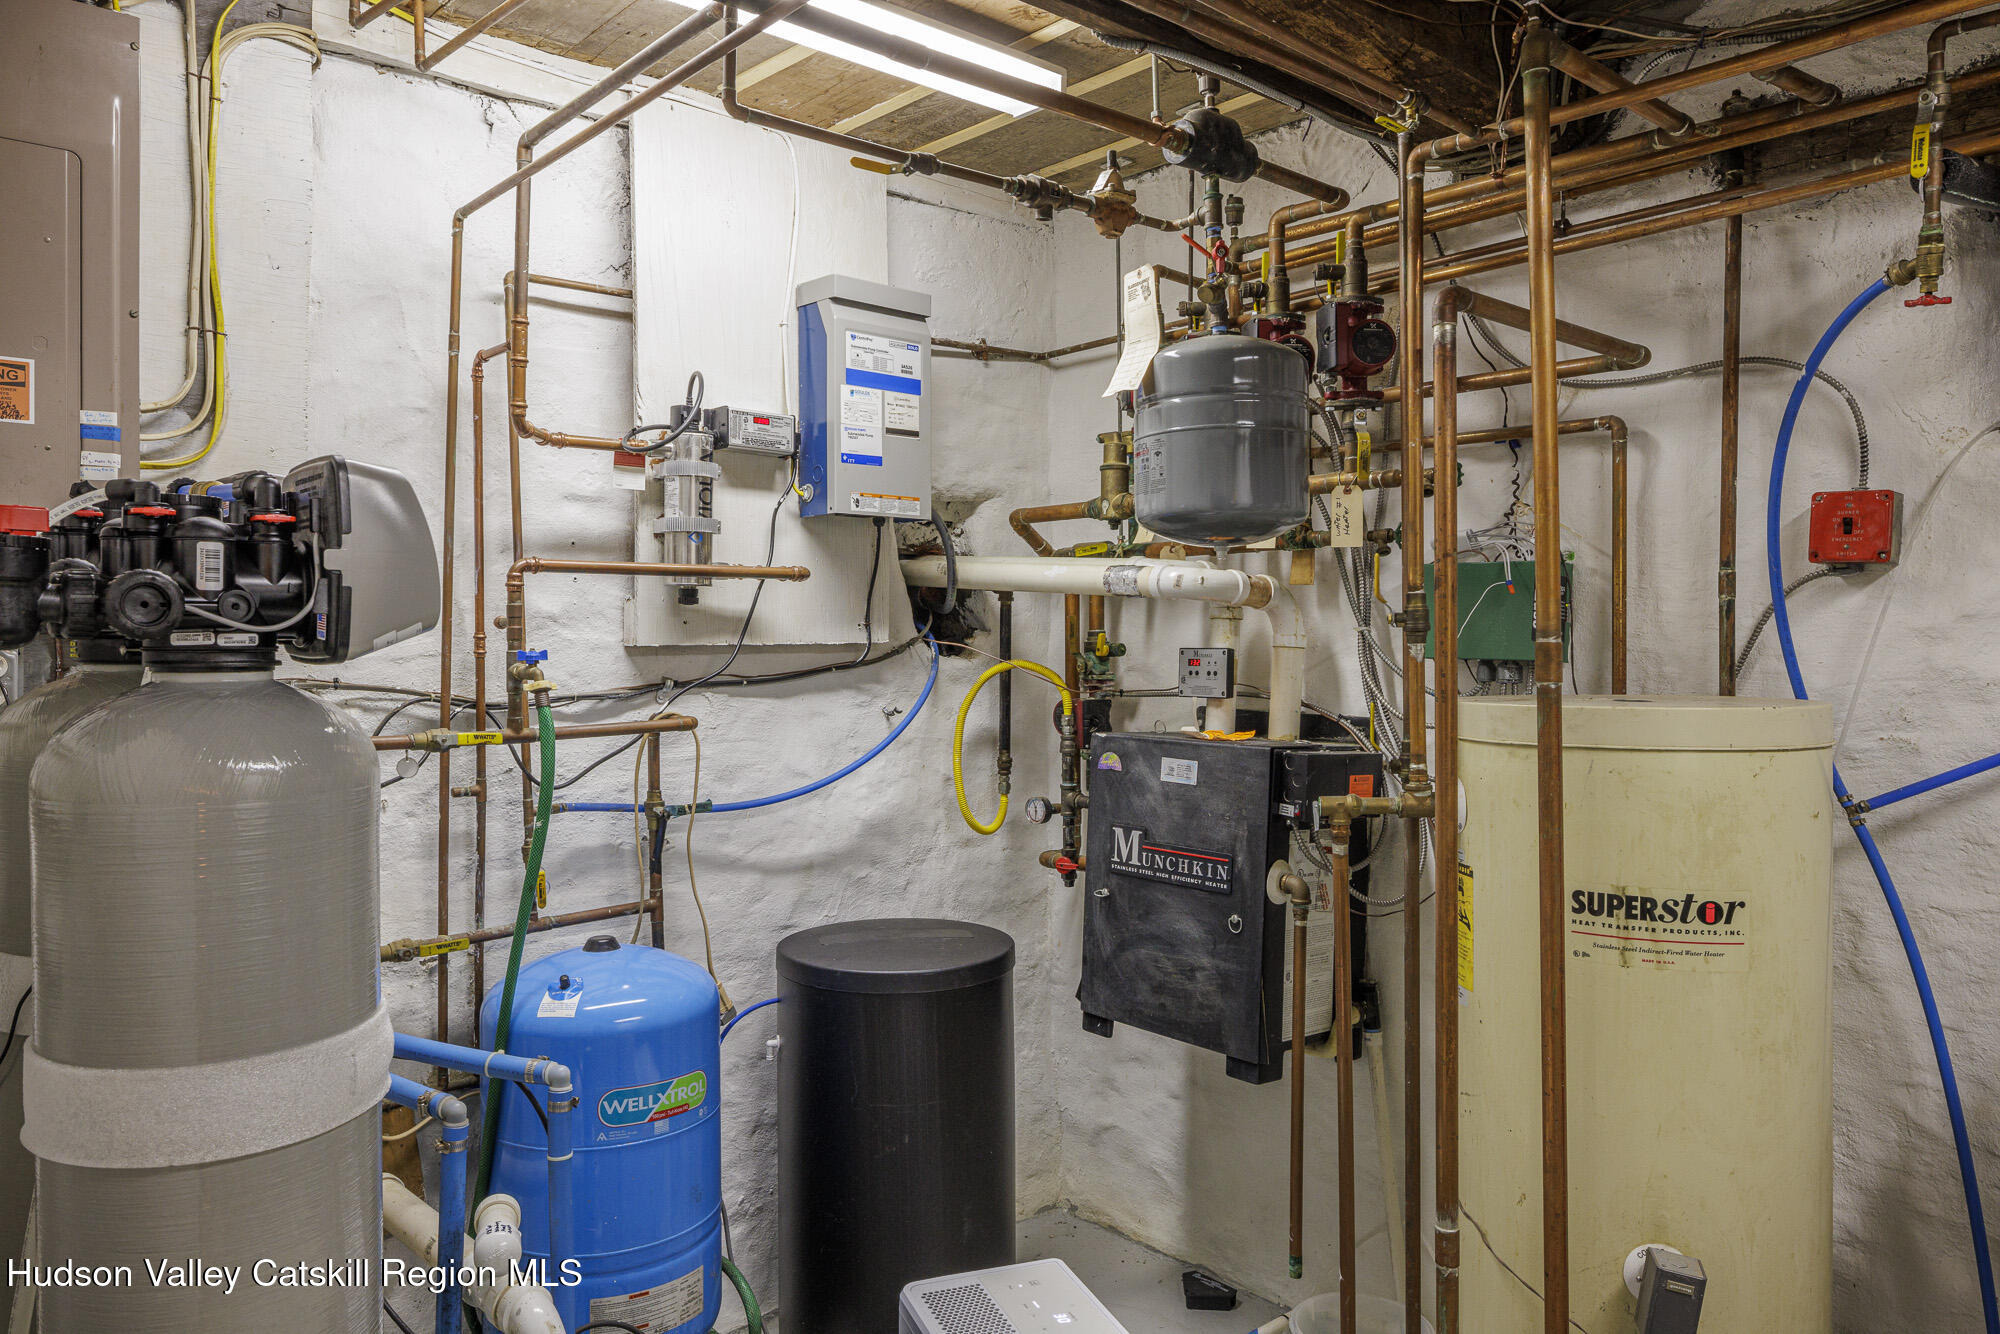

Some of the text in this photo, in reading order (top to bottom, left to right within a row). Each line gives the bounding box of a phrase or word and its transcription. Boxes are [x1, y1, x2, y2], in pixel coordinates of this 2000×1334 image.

[1111, 863, 1228, 889] STAINLESS STEEL HIGH EFFICIENCY HEATER
[1571, 919, 1596, 927] HEAT
[1602, 922, 1657, 933] TRANSFER
[1662, 928, 1722, 937] PRODUCTS,
[1592, 942, 1620, 951] Stainless
[1622, 944, 1637, 953] Steel
[1638, 947, 1684, 956] Indirect-Fired
